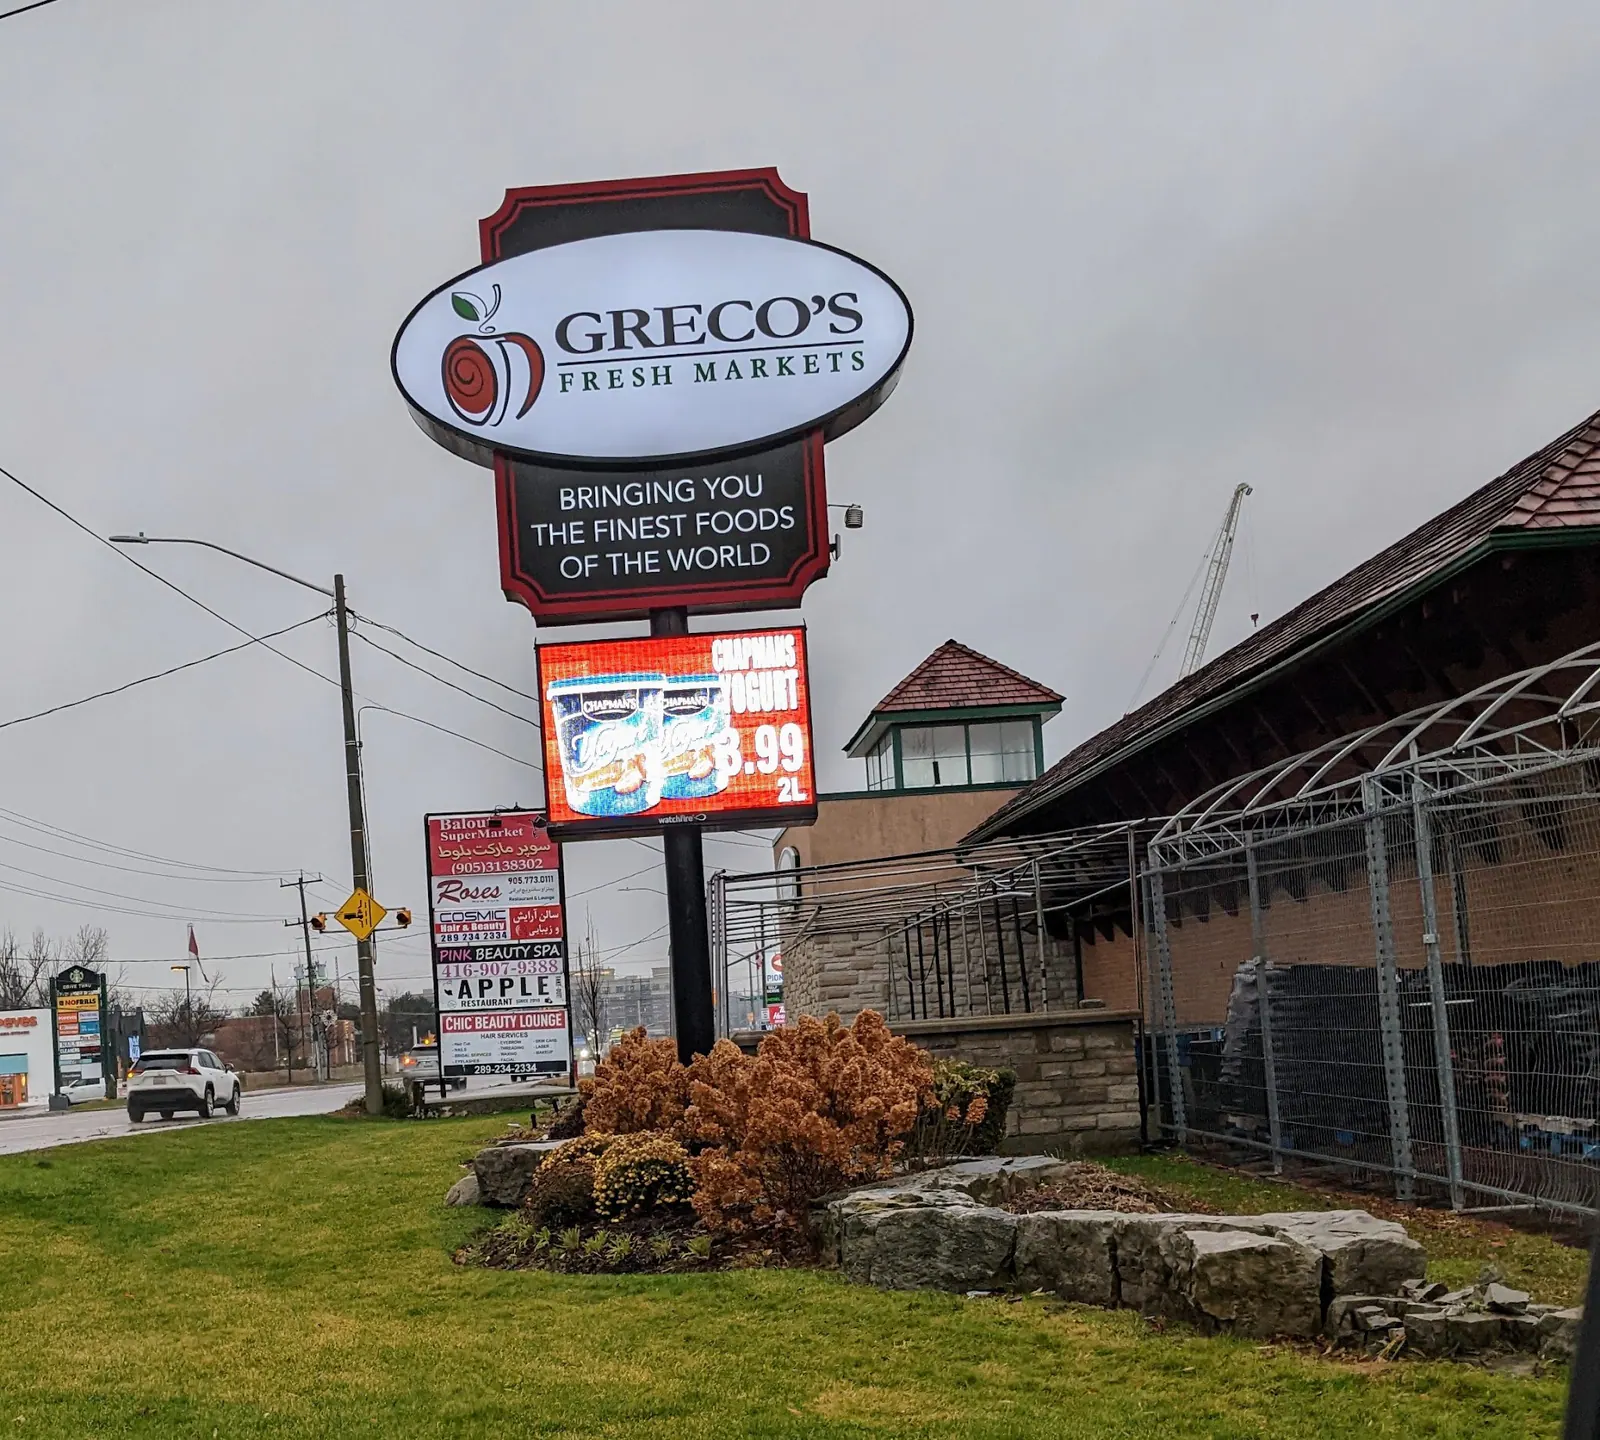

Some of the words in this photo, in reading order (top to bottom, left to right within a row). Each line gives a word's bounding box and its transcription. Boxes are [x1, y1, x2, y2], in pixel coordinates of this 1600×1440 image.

[554, 292, 864, 354] GRECO'S
[559, 364, 673, 393] FRESH
[693, 350, 866, 384] MARKETS
[559, 478, 696, 511] BRINGING
[702, 473, 763, 499] YOU
[531, 521, 584, 546] THE
[593, 513, 687, 543] FINEST
[695, 505, 796, 536] FOODS
[559, 553, 598, 579] OF
[605, 549, 660, 575] THE
[666, 543, 771, 570] WORLD
[777, 776, 808, 803] 2L
[658, 814, 693, 824] watchfire
[440, 828, 523, 842] SuperMarket
[438, 845, 472, 860] بلوط
[517, 843, 551, 858] سوپر
[451, 858, 544, 875] (905)3138302
[436, 879, 503, 904] Roses
[440, 910, 506, 923] COSMIC
[539, 910, 559, 922] سالن
[440, 923, 460, 932] Hair
[471, 921, 505, 931] Beauty
[441, 934, 459, 942] 289
[462, 933, 480, 941] 234
[484, 931, 507, 939] 2334
[440, 949, 472, 962] PINK
[475, 945, 532, 961] BEAUTY
[533, 944, 560, 958] SPA
[442, 959, 558, 978] 416-907-9388
[766, 974, 784, 982] PION
[458, 976, 550, 999] APPLE
[461, 998, 513, 1008] RESTAURANT
[445, 1015, 472, 1031] CHIC
[475, 1014, 517, 1030] BEAUTY
[519, 1012, 562, 1028] LOUNGE
[480, 1032, 496, 1040] HAIR
[474, 1063, 537, 1074] 289-234-2334
